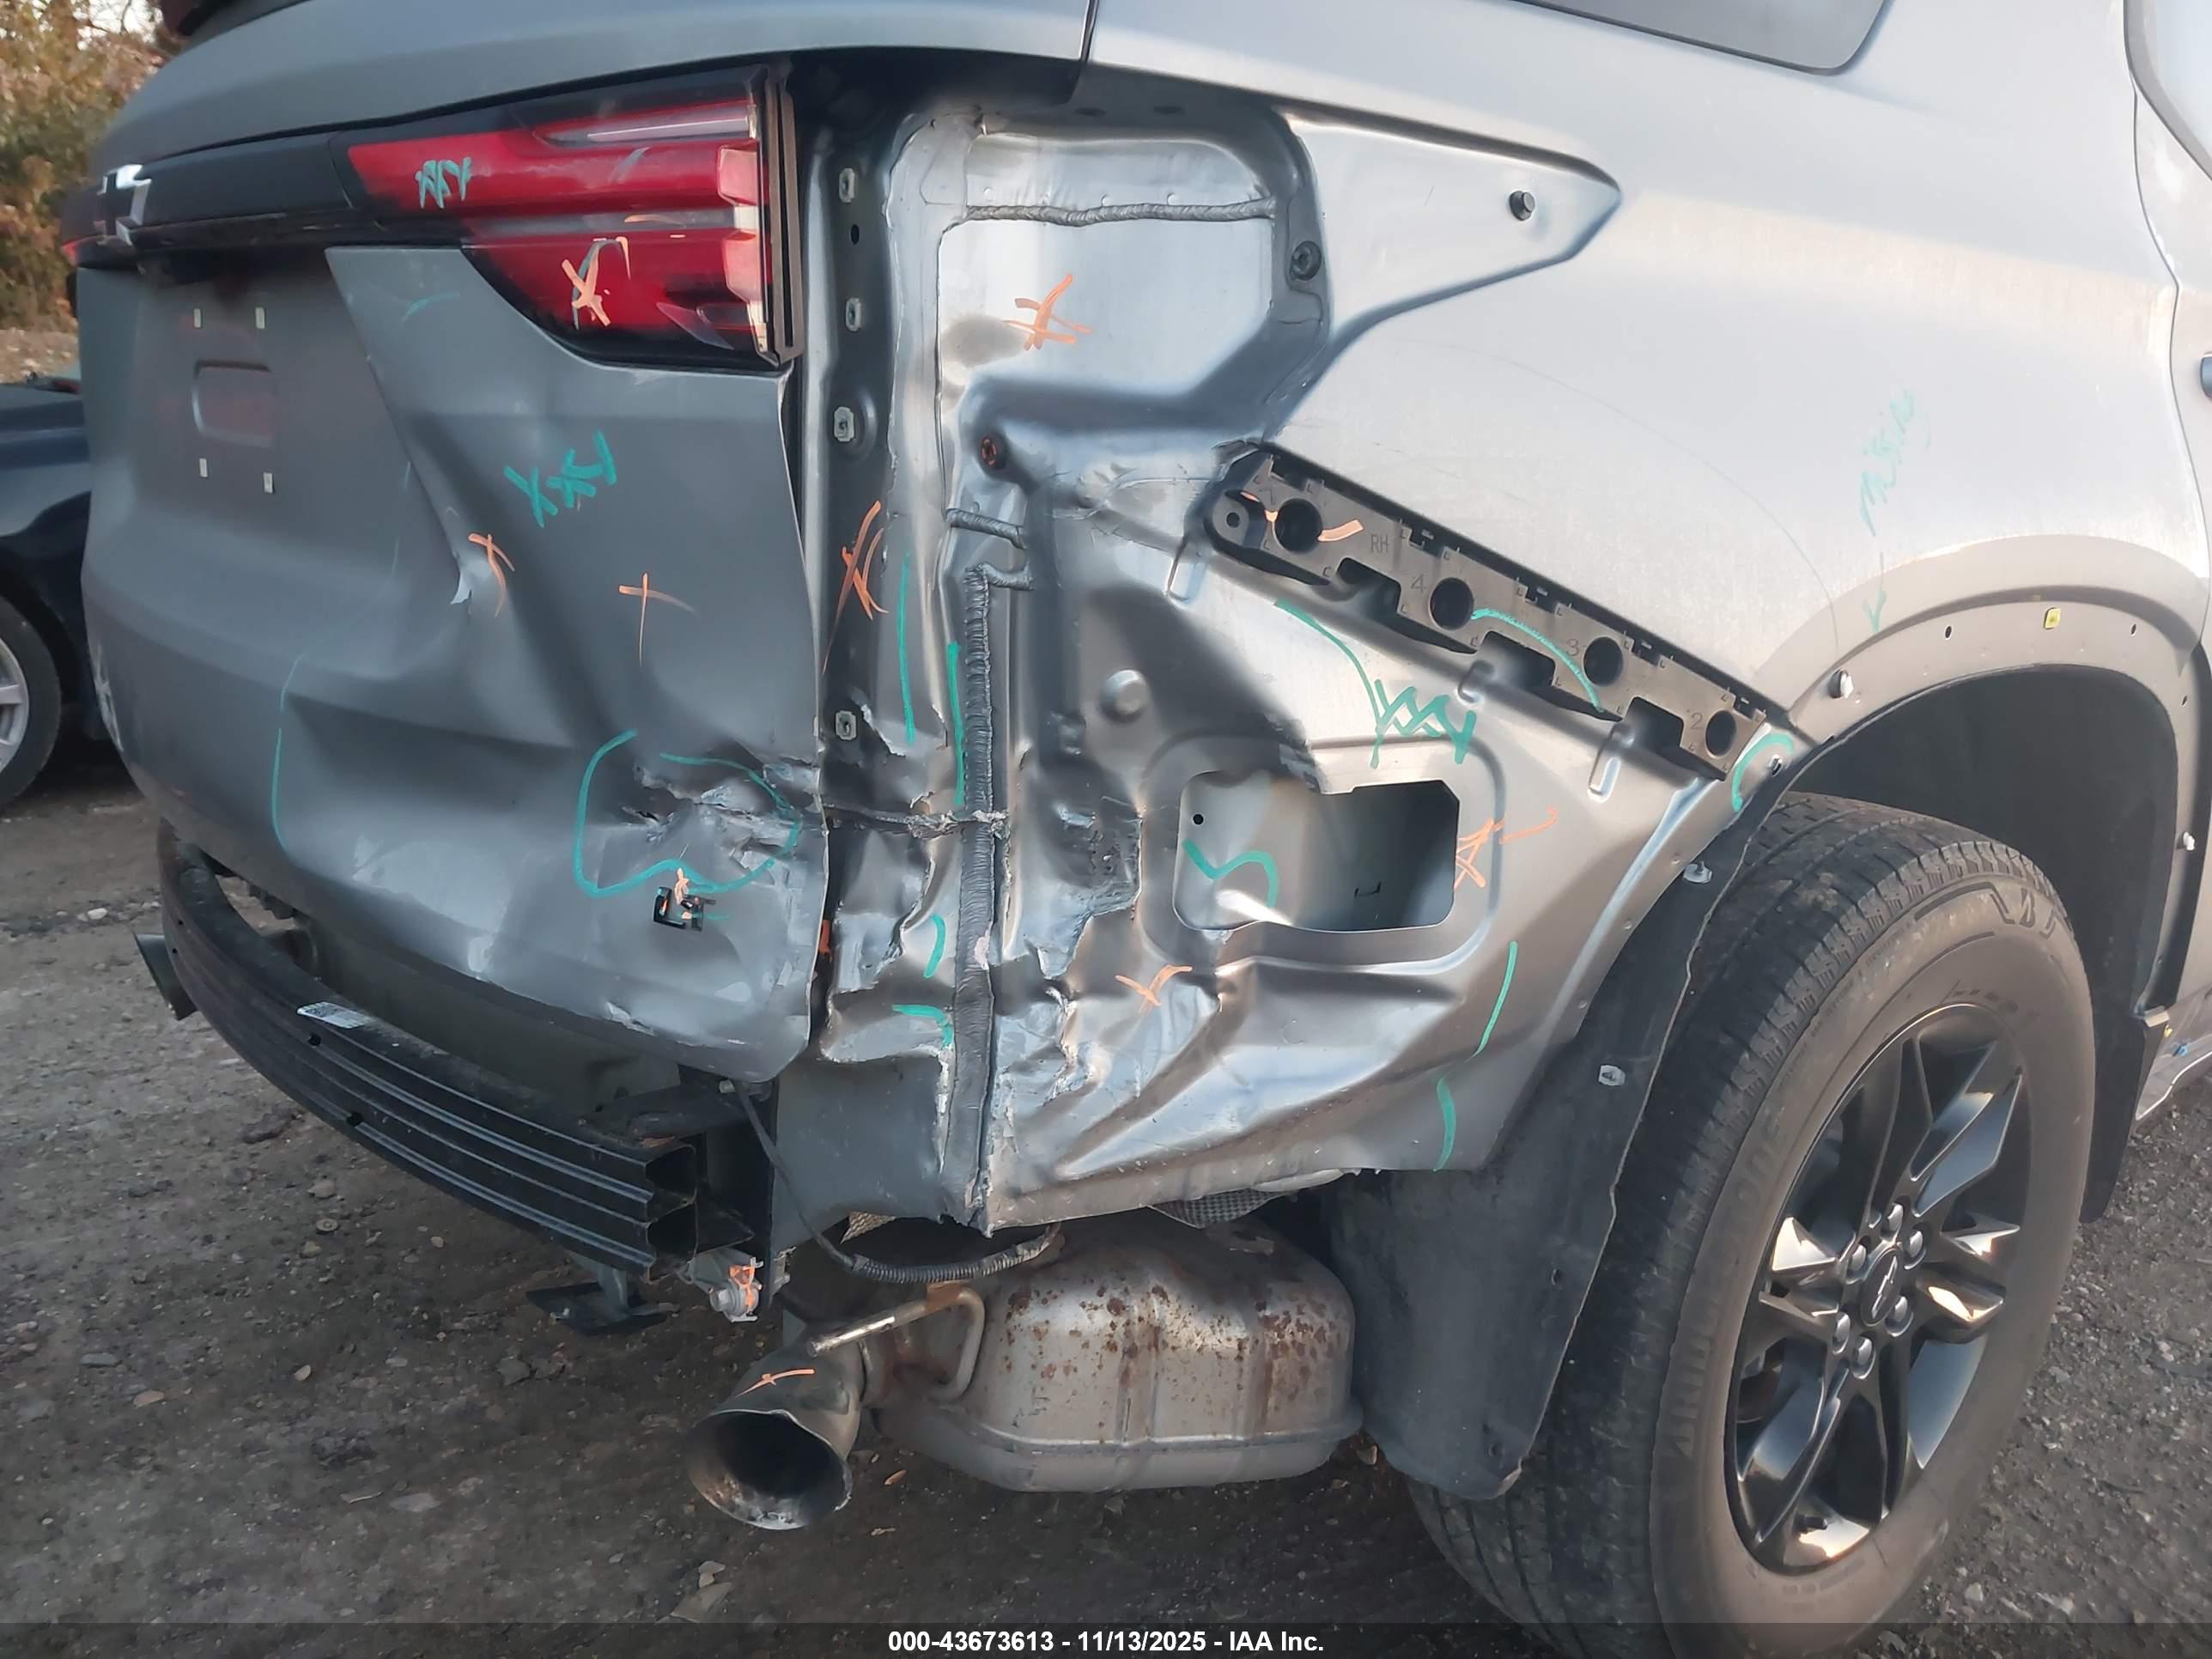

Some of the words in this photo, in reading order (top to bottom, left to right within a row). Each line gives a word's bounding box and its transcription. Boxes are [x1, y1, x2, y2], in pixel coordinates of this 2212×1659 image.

[1370, 532, 1390, 554] RH
[1410, 574, 1427, 593] 4
[1565, 638, 1579, 657] 3
[1690, 712, 1704, 730] 2
